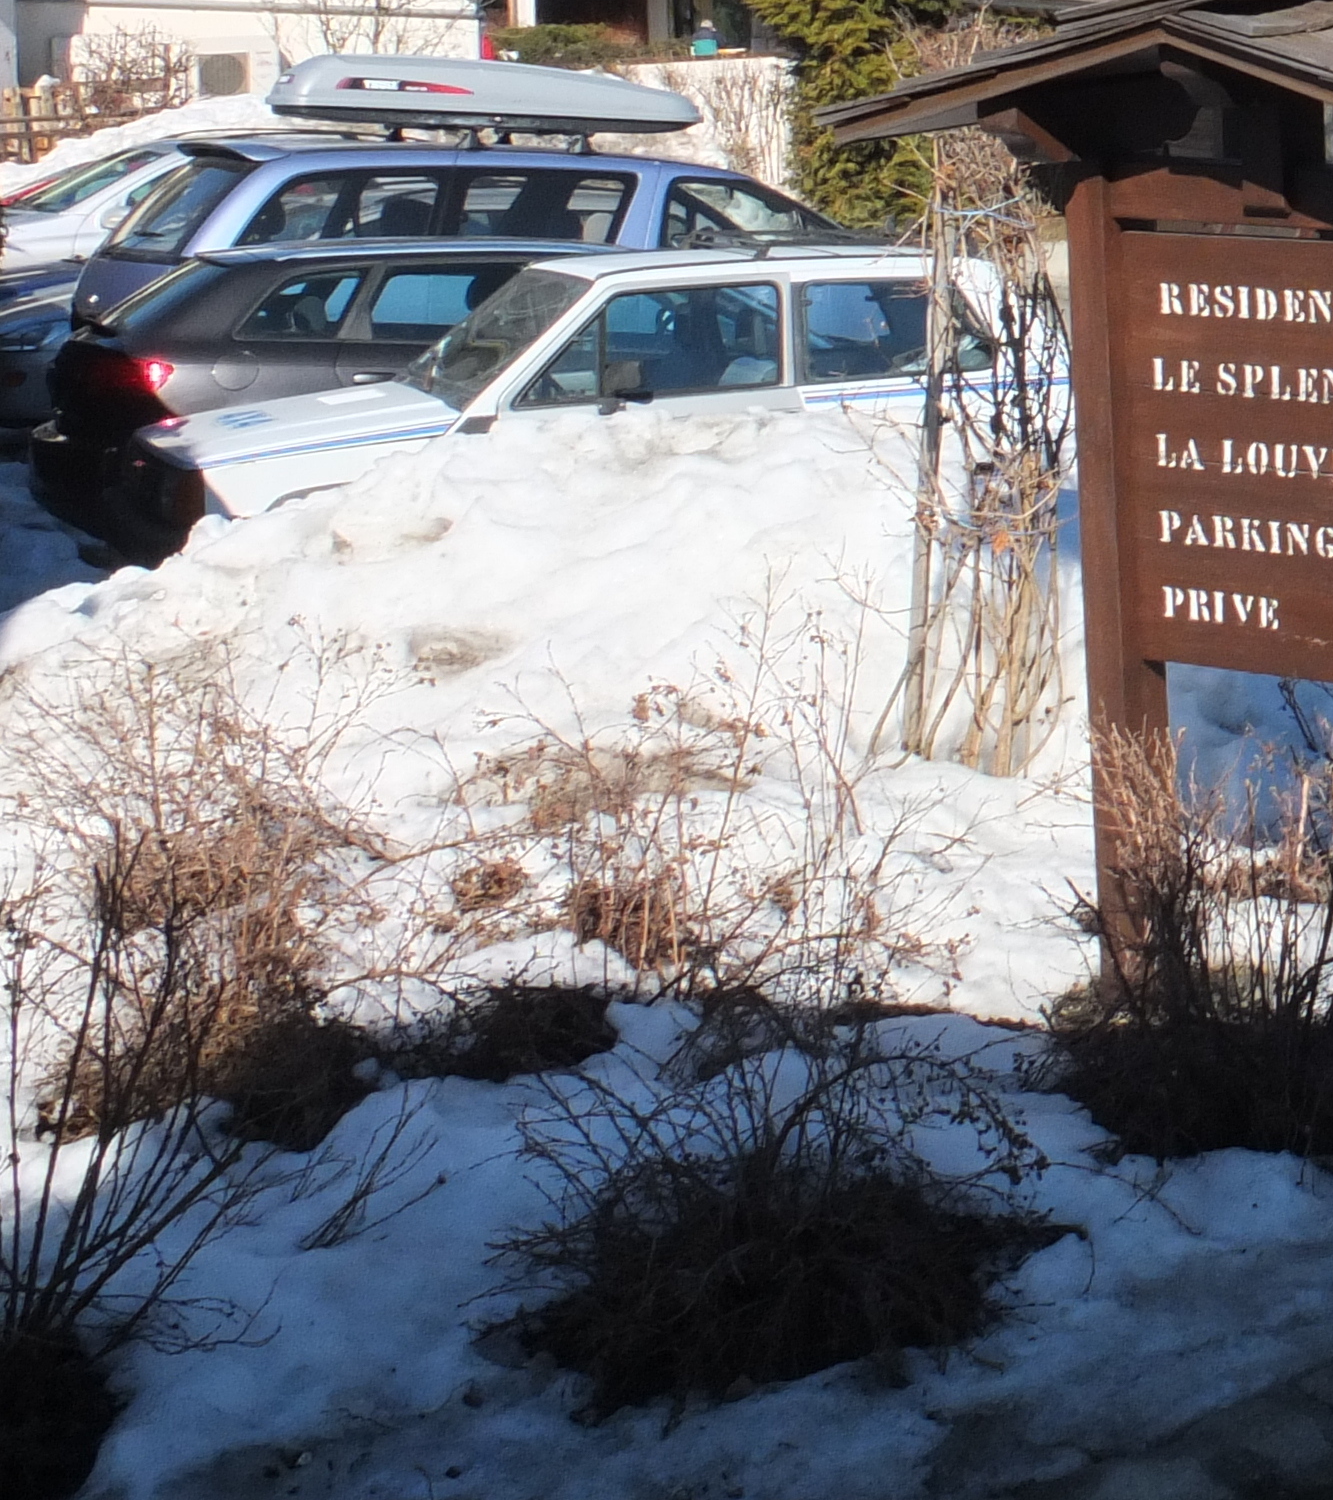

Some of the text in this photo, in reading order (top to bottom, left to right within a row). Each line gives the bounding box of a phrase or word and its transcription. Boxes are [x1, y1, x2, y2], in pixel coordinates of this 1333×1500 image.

[1152, 357, 1201, 394] LE
[1155, 433, 1206, 471] LA
[1162, 586, 1280, 630] PRIVE
